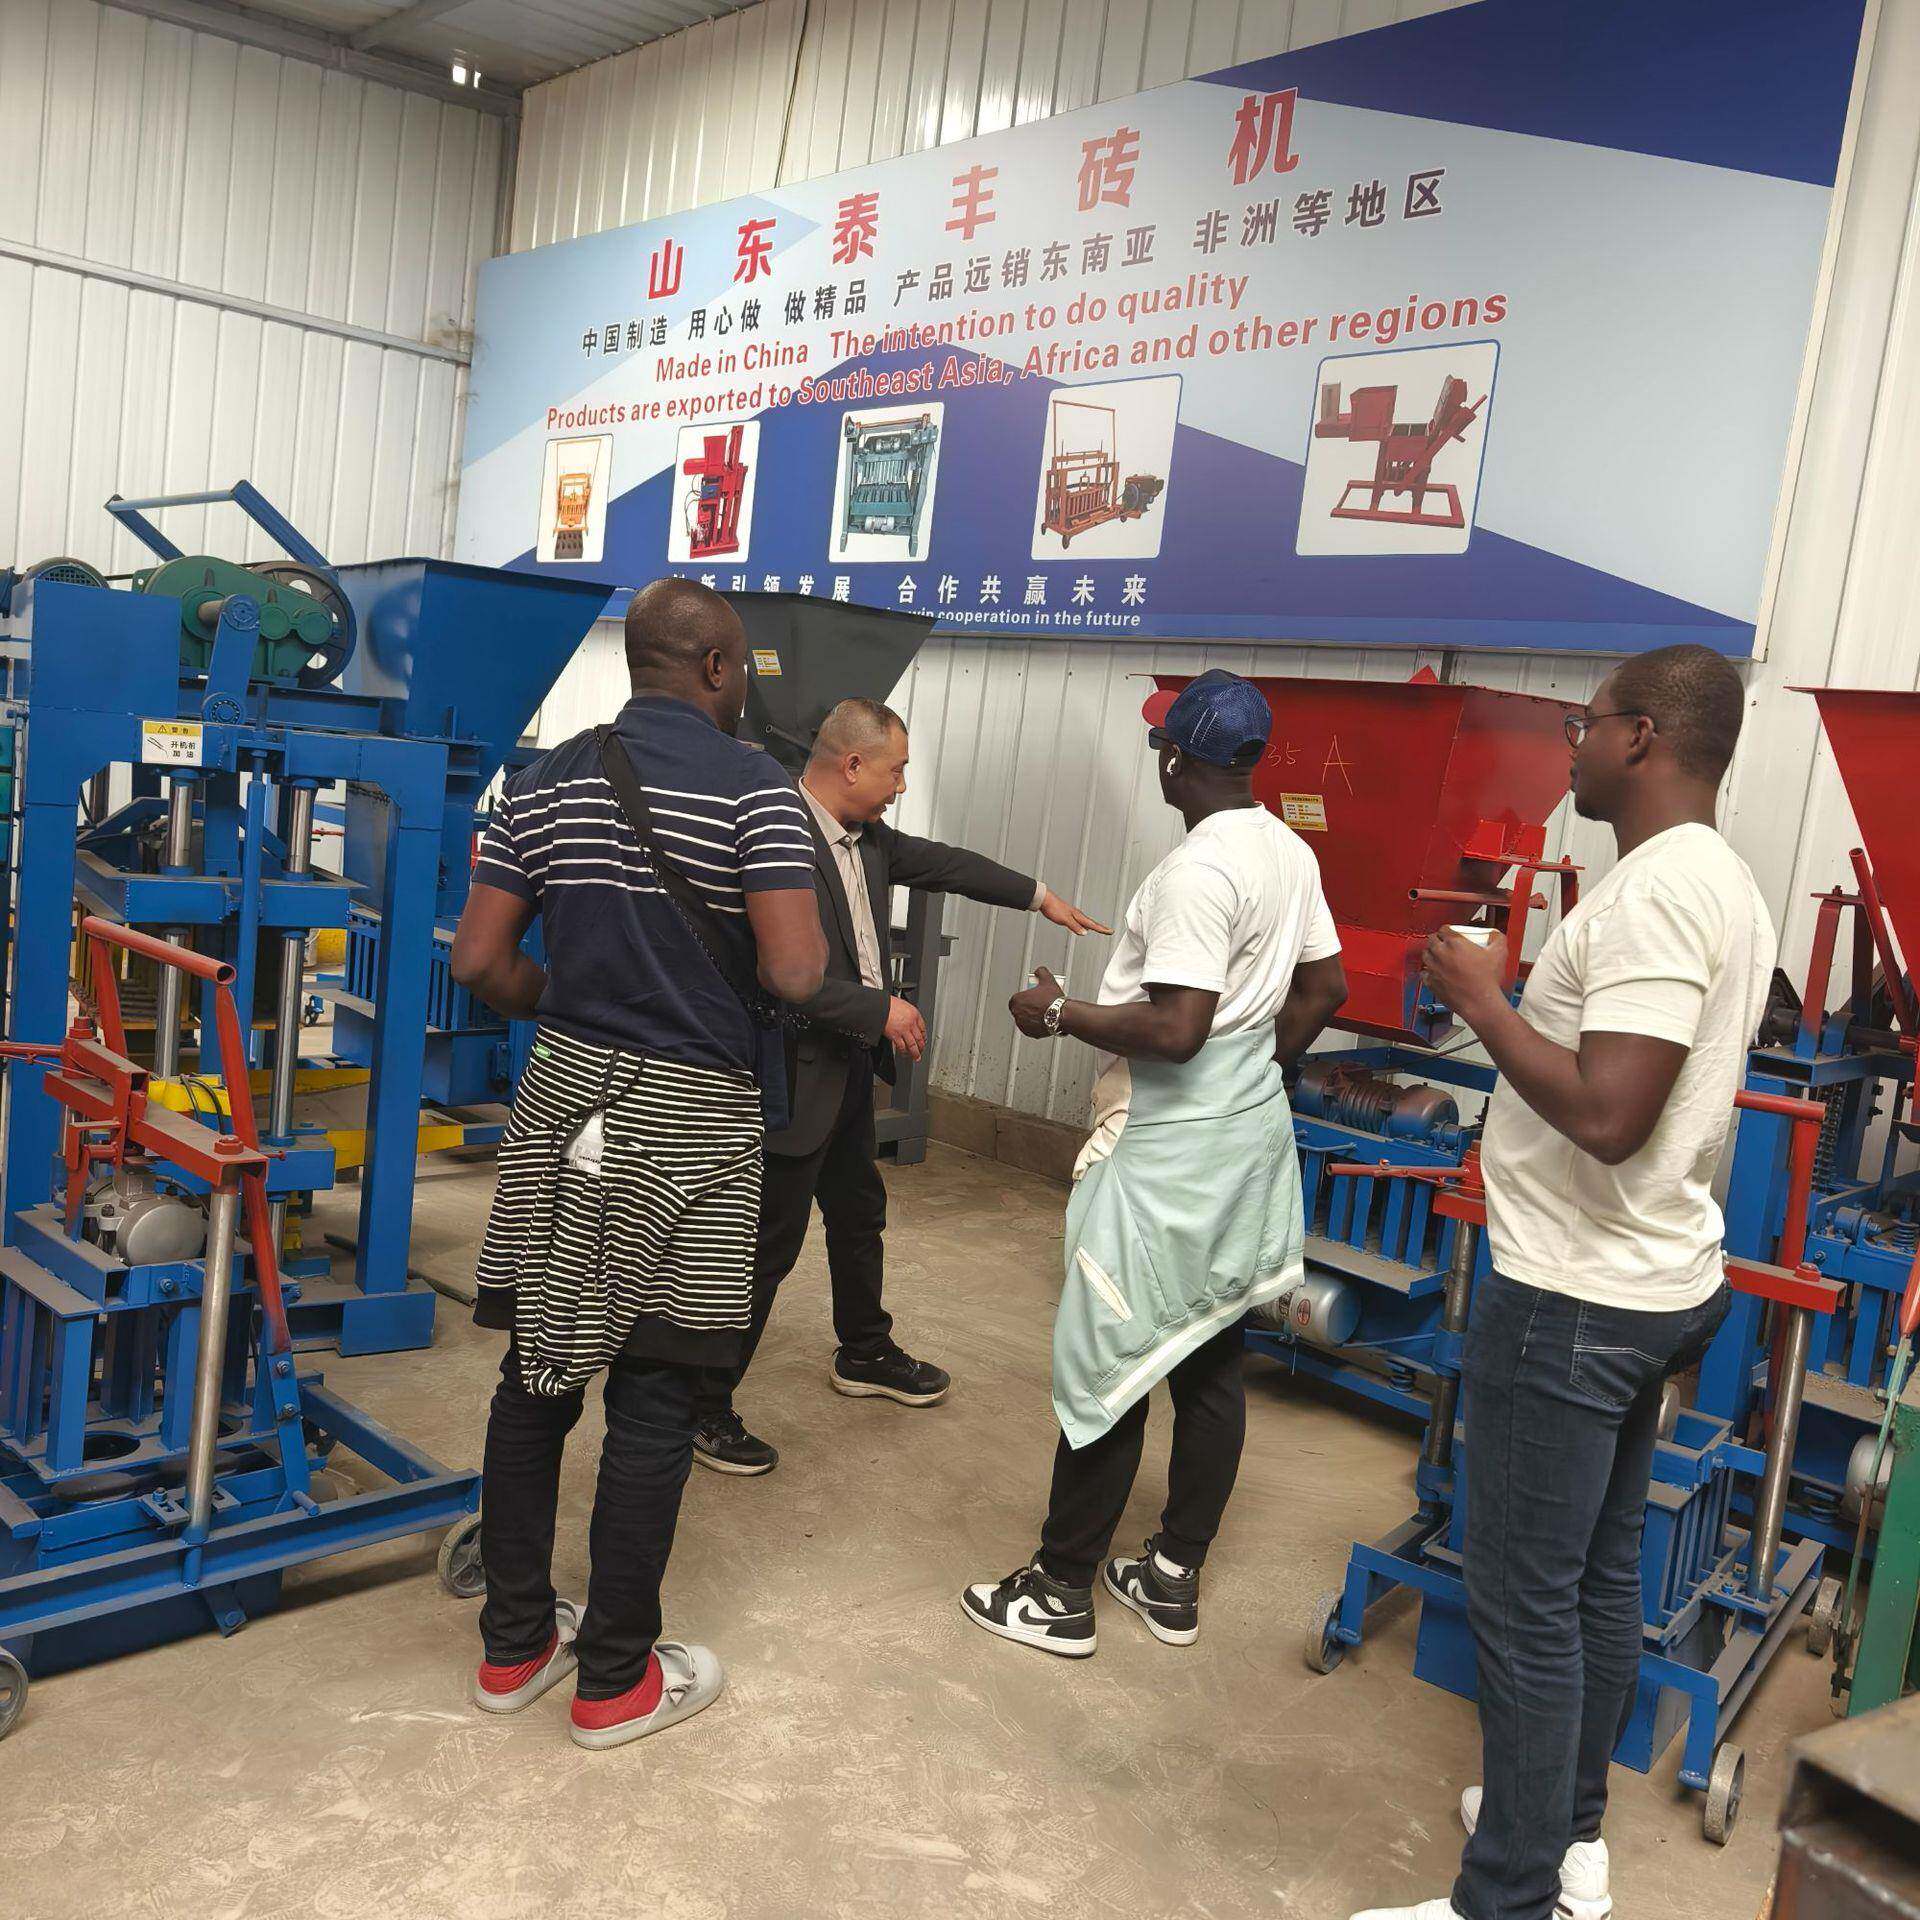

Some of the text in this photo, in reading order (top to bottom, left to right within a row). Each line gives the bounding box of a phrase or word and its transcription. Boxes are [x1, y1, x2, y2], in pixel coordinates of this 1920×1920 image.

[648, 86, 1300, 300] 山东泰丰砖机
[582, 168, 1446, 358] 中国制造 用心做 做精品 产品远销东南亚 非洲等地区
[547, 293, 1508, 430] Products are exported to Southeast Asia, Africa and other regions
[656, 272, 1250, 383] Made in China The intention to do quality
[898, 574, 1147, 606] 合作共赢未来
[937, 608, 1031, 626] cooperation
[1034, 610, 1050, 625] in
[1054, 609, 1082, 626] the
[1085, 611, 1141, 627] future
[1321, 735, 1355, 797] A
